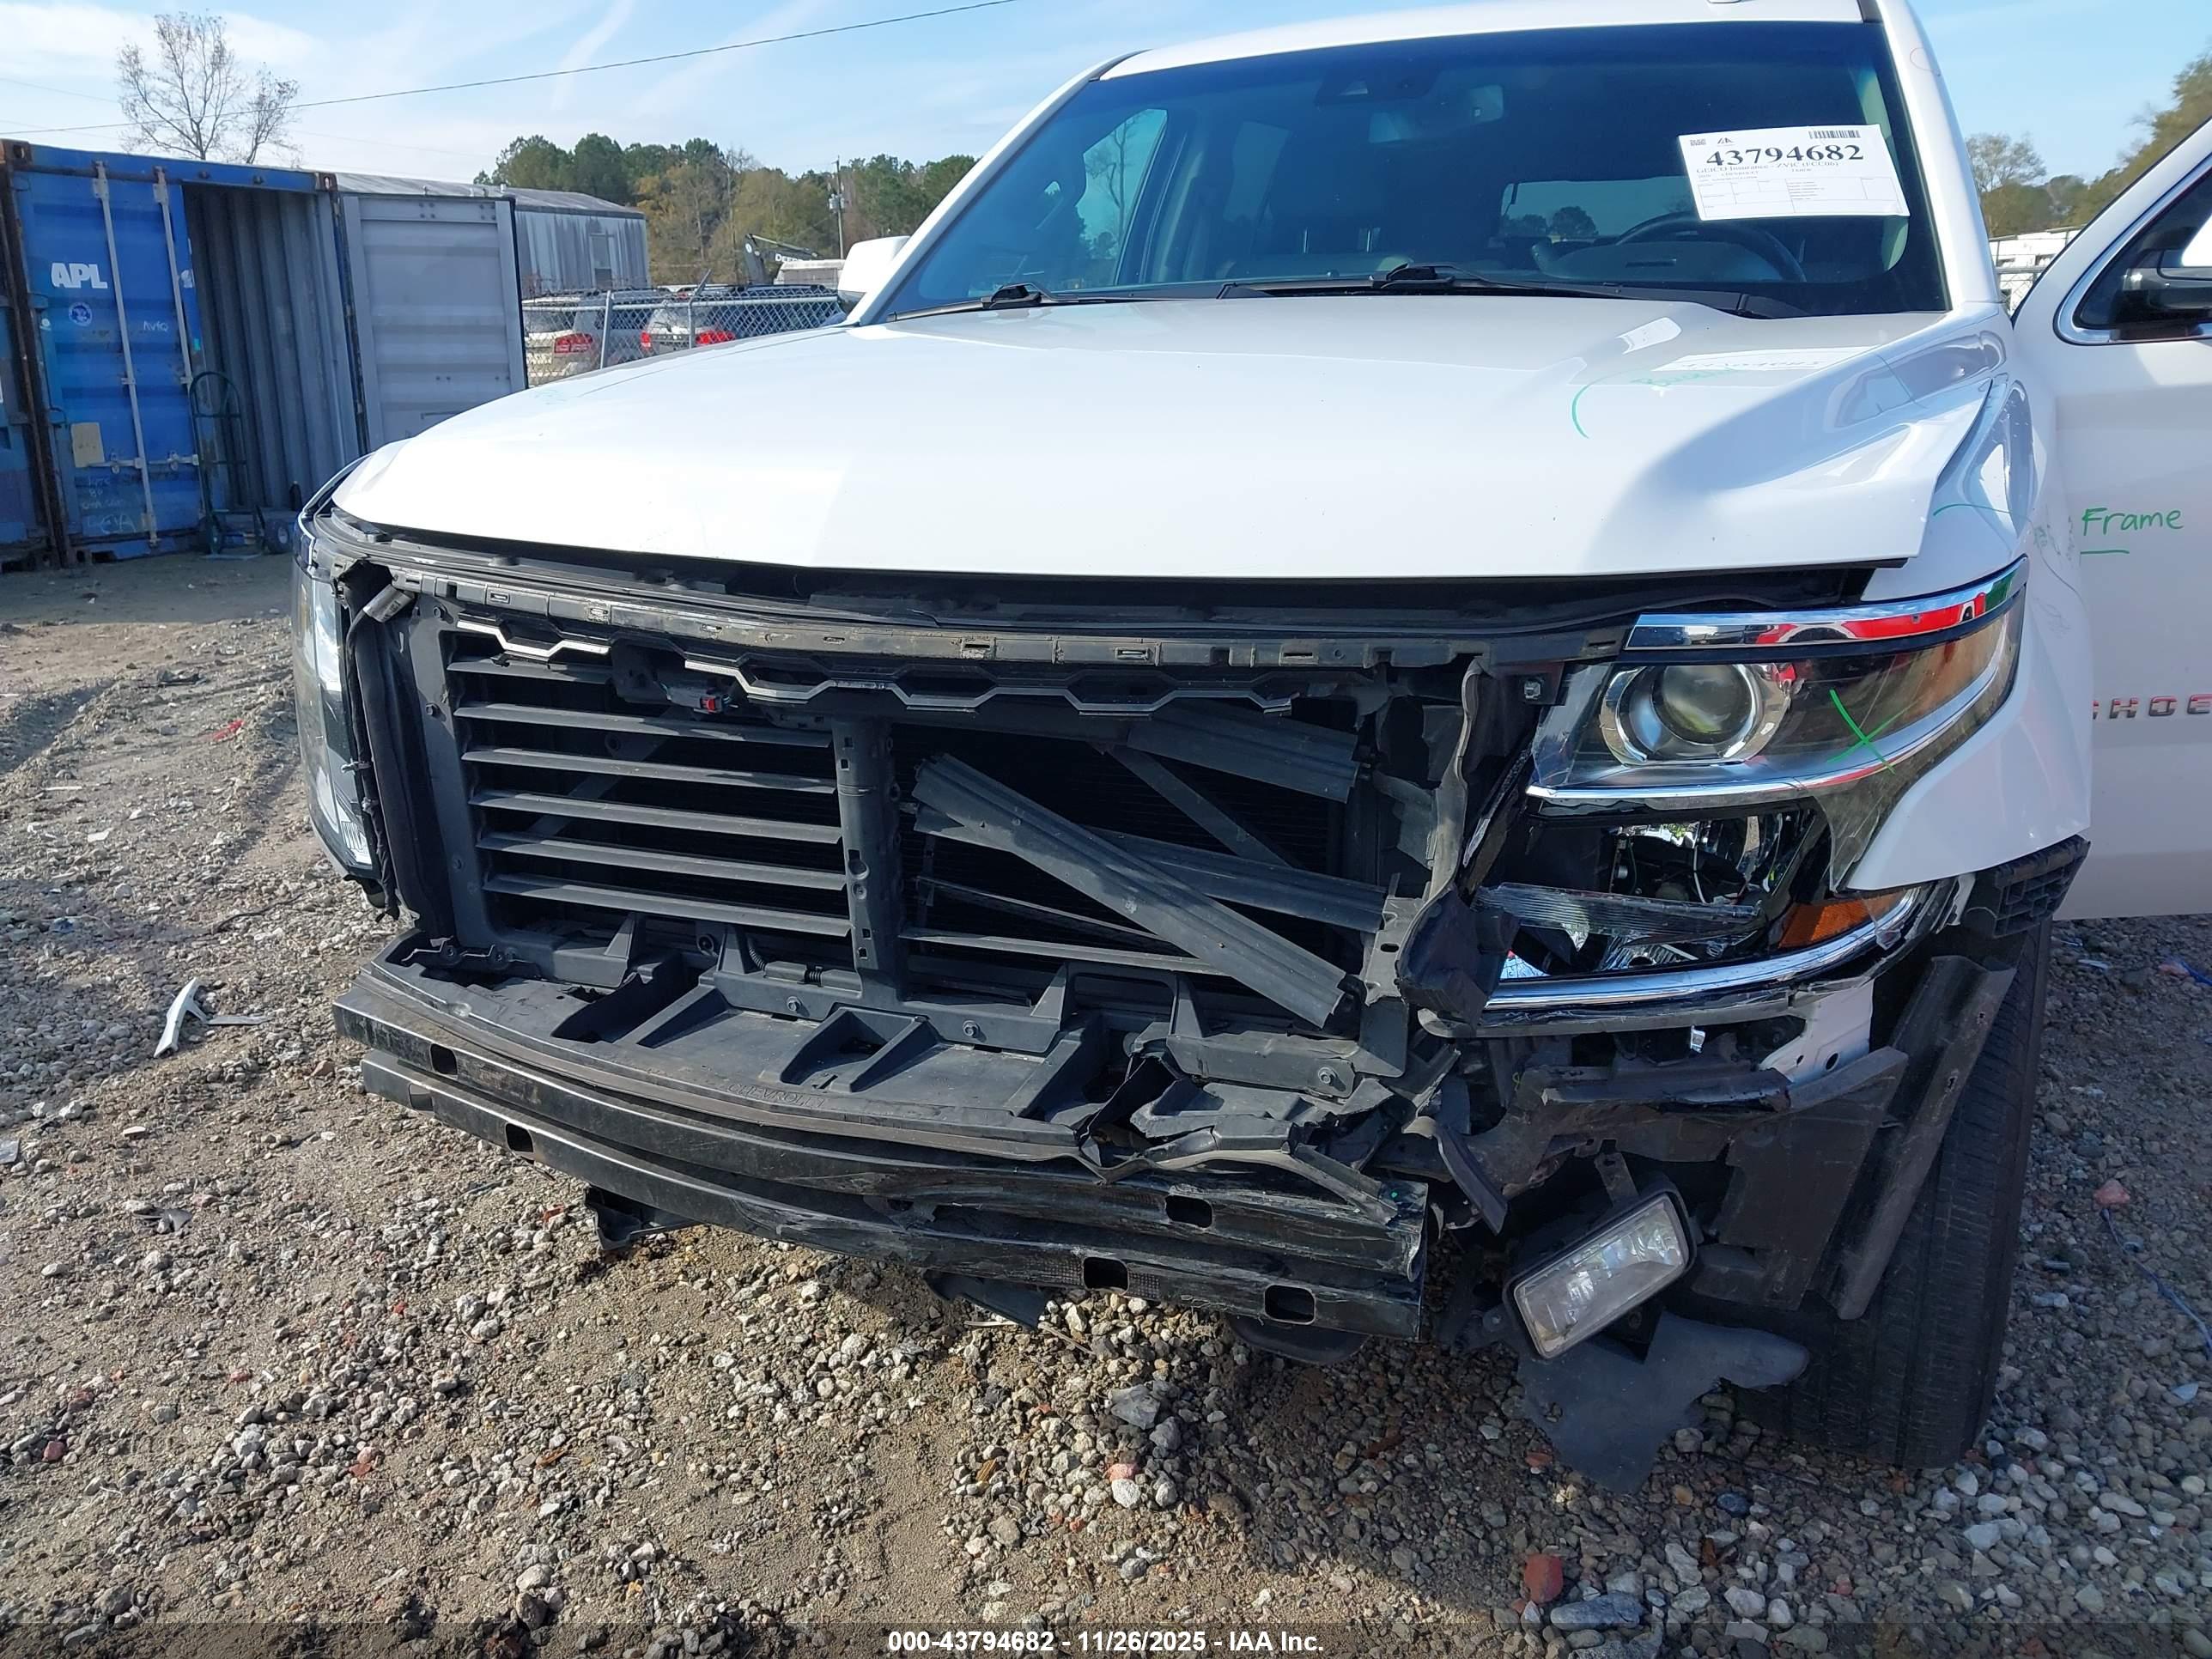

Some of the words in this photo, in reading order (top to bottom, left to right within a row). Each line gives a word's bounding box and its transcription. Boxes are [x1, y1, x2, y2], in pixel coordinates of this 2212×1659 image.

[1706, 144, 1864, 166] 43794682
[51, 262, 108, 289] APL
[2081, 507, 2185, 536] Frame
